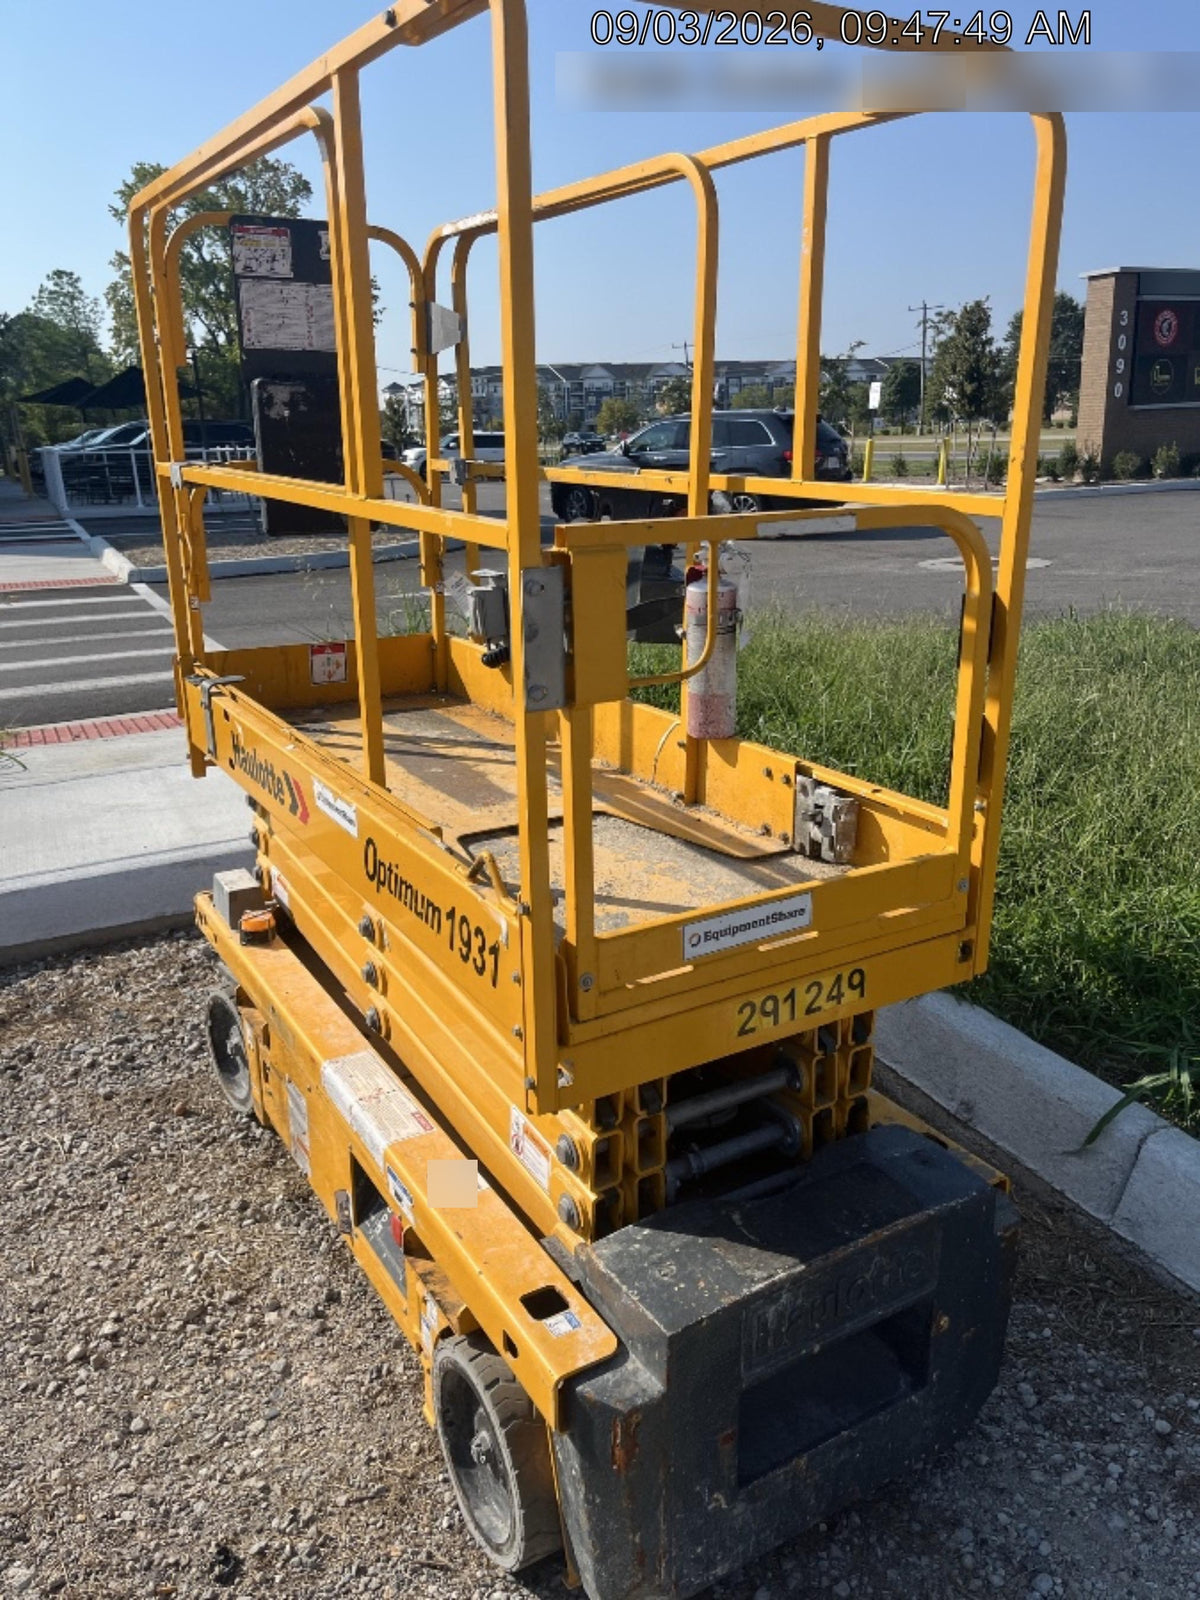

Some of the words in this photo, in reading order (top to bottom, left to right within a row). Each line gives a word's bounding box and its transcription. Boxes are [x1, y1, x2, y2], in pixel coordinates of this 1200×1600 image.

[1114, 310, 1129, 398] 3090
[364, 837, 442, 934] Optimum
[445, 906, 500, 989] 1931
[703, 907, 807, 943] EquipmentShare
[737, 967, 866, 1037] 291249
